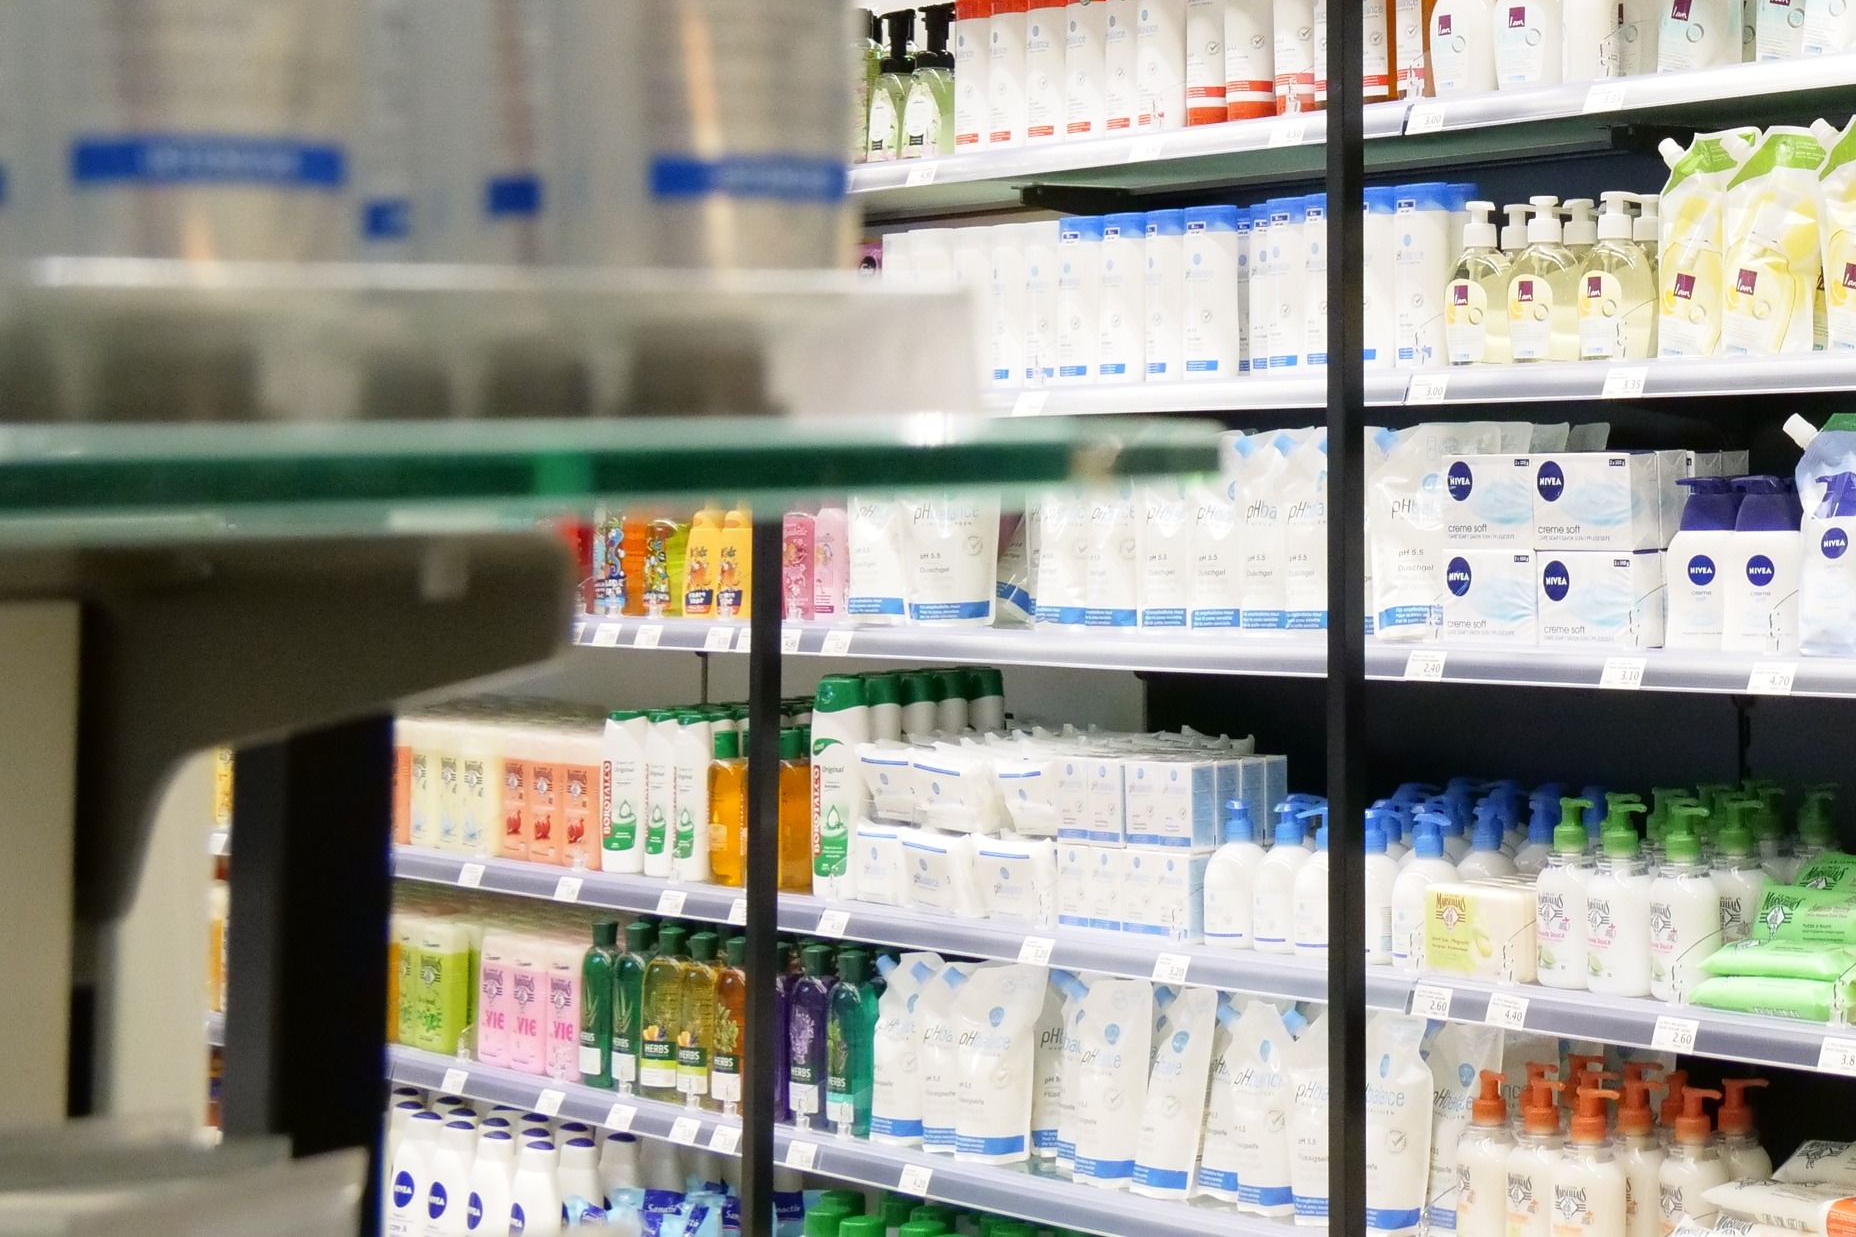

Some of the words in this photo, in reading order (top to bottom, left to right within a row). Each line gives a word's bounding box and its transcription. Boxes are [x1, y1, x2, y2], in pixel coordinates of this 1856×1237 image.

[1425, 114, 1441, 125] 3.00
[1623, 380, 1641, 390] 3.35
[1426, 386, 1443, 397] 3.00
[1449, 476, 1471, 485] NIVEA
[1539, 477, 1562, 486] NIVEA
[1448, 525, 1473, 533] creme
[1474, 523, 1488, 533] soft
[1538, 526, 1564, 534] creme
[1566, 524, 1581, 534] soft
[1823, 539, 1846, 547] NIVEA
[1690, 566, 1713, 574] NIVEA
[1749, 567, 1772, 575] NIVEA
[1448, 572, 1470, 581] NIVEA
[1545, 576, 1567, 586] NIVEA
[1447, 620, 1471, 628] creme
[1473, 620, 1487, 628] soft
[1544, 626, 1570, 634] creme
[1571, 625, 1586, 634] soft
[1423, 662, 1442, 674] 2.40
[1620, 670, 1640, 682] 3.10
[1769, 675, 1790, 687] 4.70
[812, 767, 821, 854] BOROTALCO
[1168, 966, 1184, 977] 3.20
[1429, 1001, 1448, 1012] 2.60
[1504, 1010, 1523, 1022] 4.40
[1672, 1033, 1692, 1044] 2.60
[644, 1043, 670, 1055] HERBS
[678, 1049, 701, 1061] HERBS
[714, 1056, 734, 1068] HERBS
[790, 1066, 812, 1079] HERBS
[827, 1075, 846, 1088] HERBS
